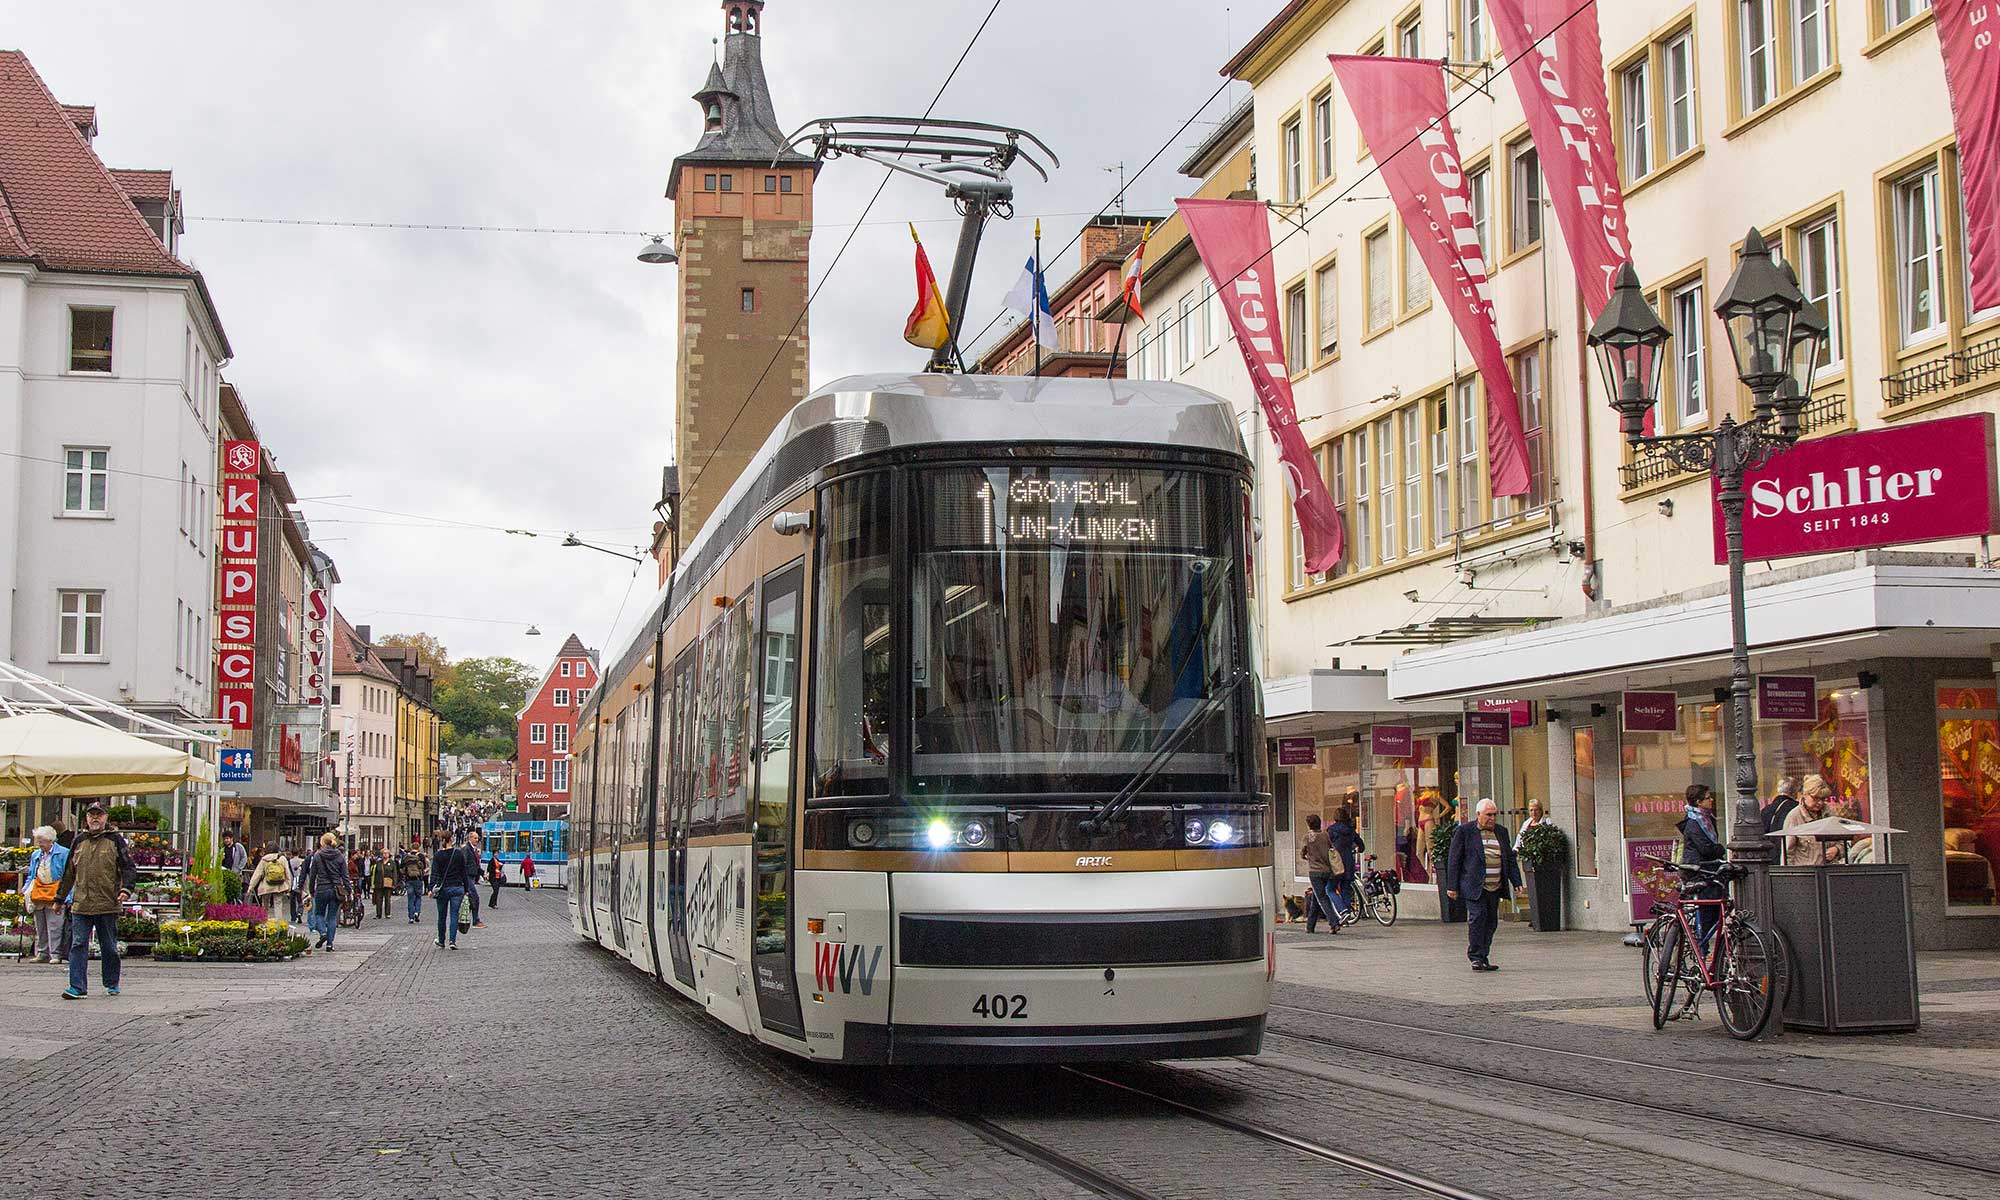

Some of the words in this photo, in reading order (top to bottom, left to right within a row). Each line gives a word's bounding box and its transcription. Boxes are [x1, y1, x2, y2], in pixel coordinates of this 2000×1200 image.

[1751, 464, 1943, 519] Schlier
[977, 481, 991, 545] 1
[1803, 518, 1841, 534] SEIT
[1850, 512, 1890, 528] 1843
[1010, 516, 1156, 541] UNI-KLINIKEN
[222, 485, 254, 724] kupsch
[221, 771, 252, 779] toiletten
[1075, 856, 1113, 867] ARTIC
[815, 941, 884, 996] WVV
[972, 994, 1028, 1019] 402
